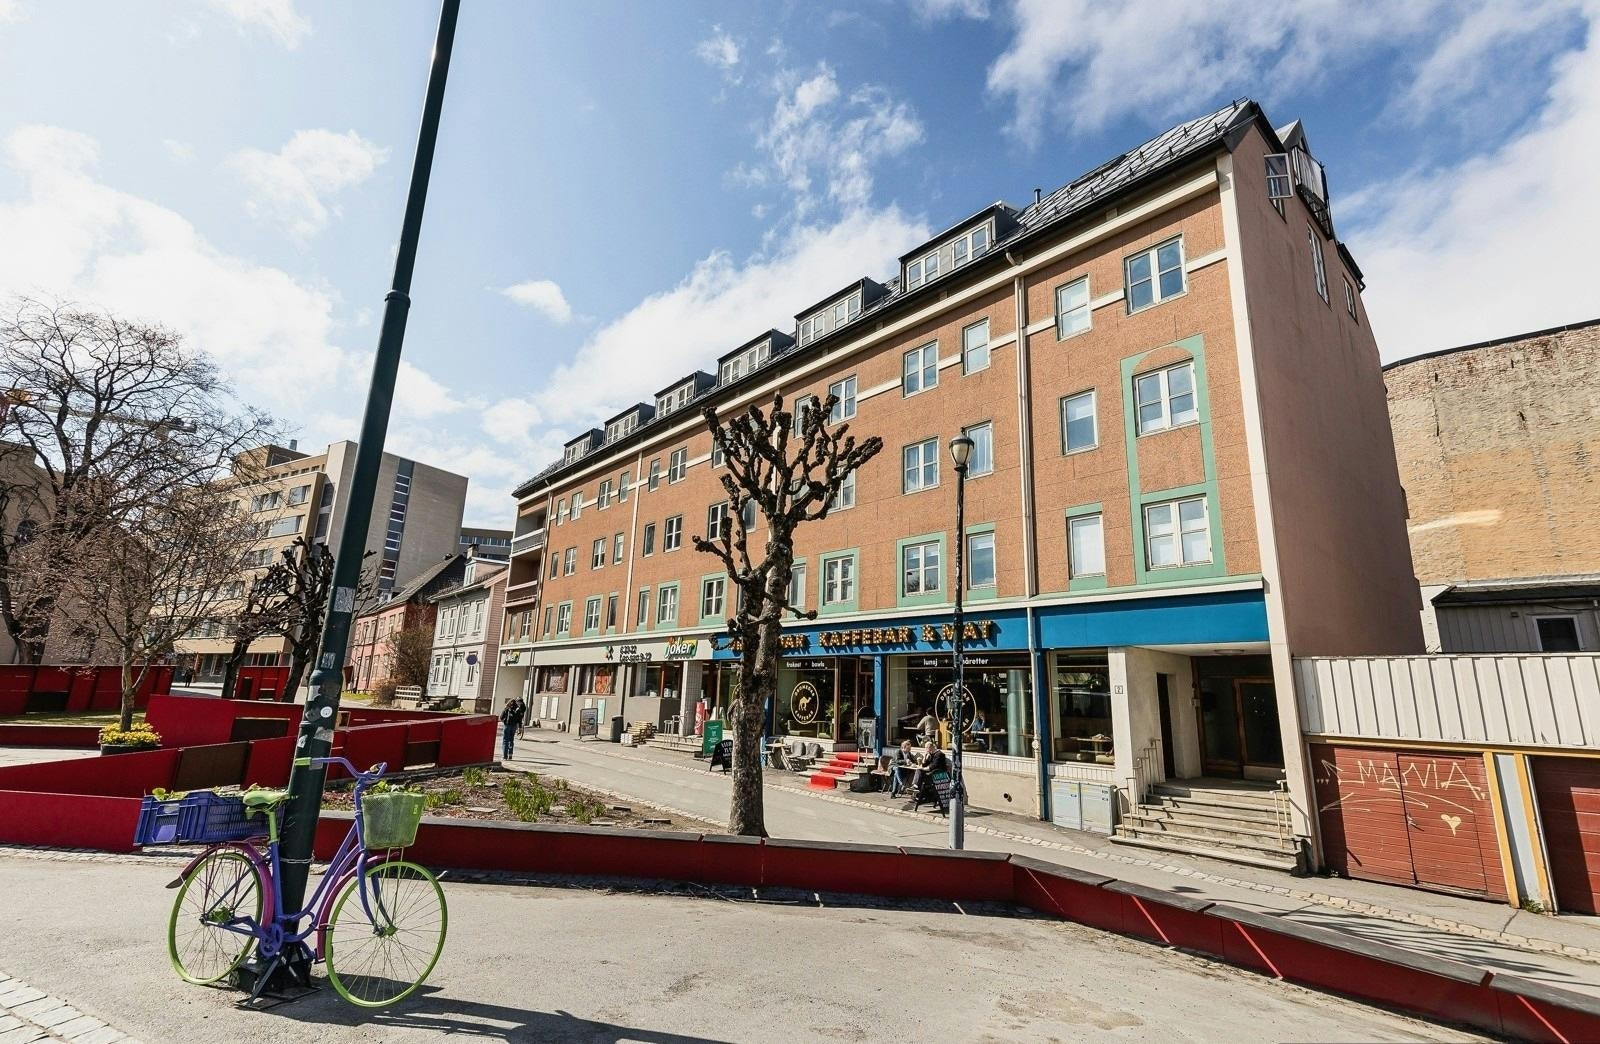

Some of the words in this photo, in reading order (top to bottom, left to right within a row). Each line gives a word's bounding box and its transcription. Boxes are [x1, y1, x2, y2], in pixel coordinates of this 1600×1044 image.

[819, 626, 909, 647] KAFFEBAR
[922, 624, 935, 641] &
[942, 620, 992, 640] MAT
[923, 658, 938, 667] lunsj
[962, 657, 989, 665] åretter
